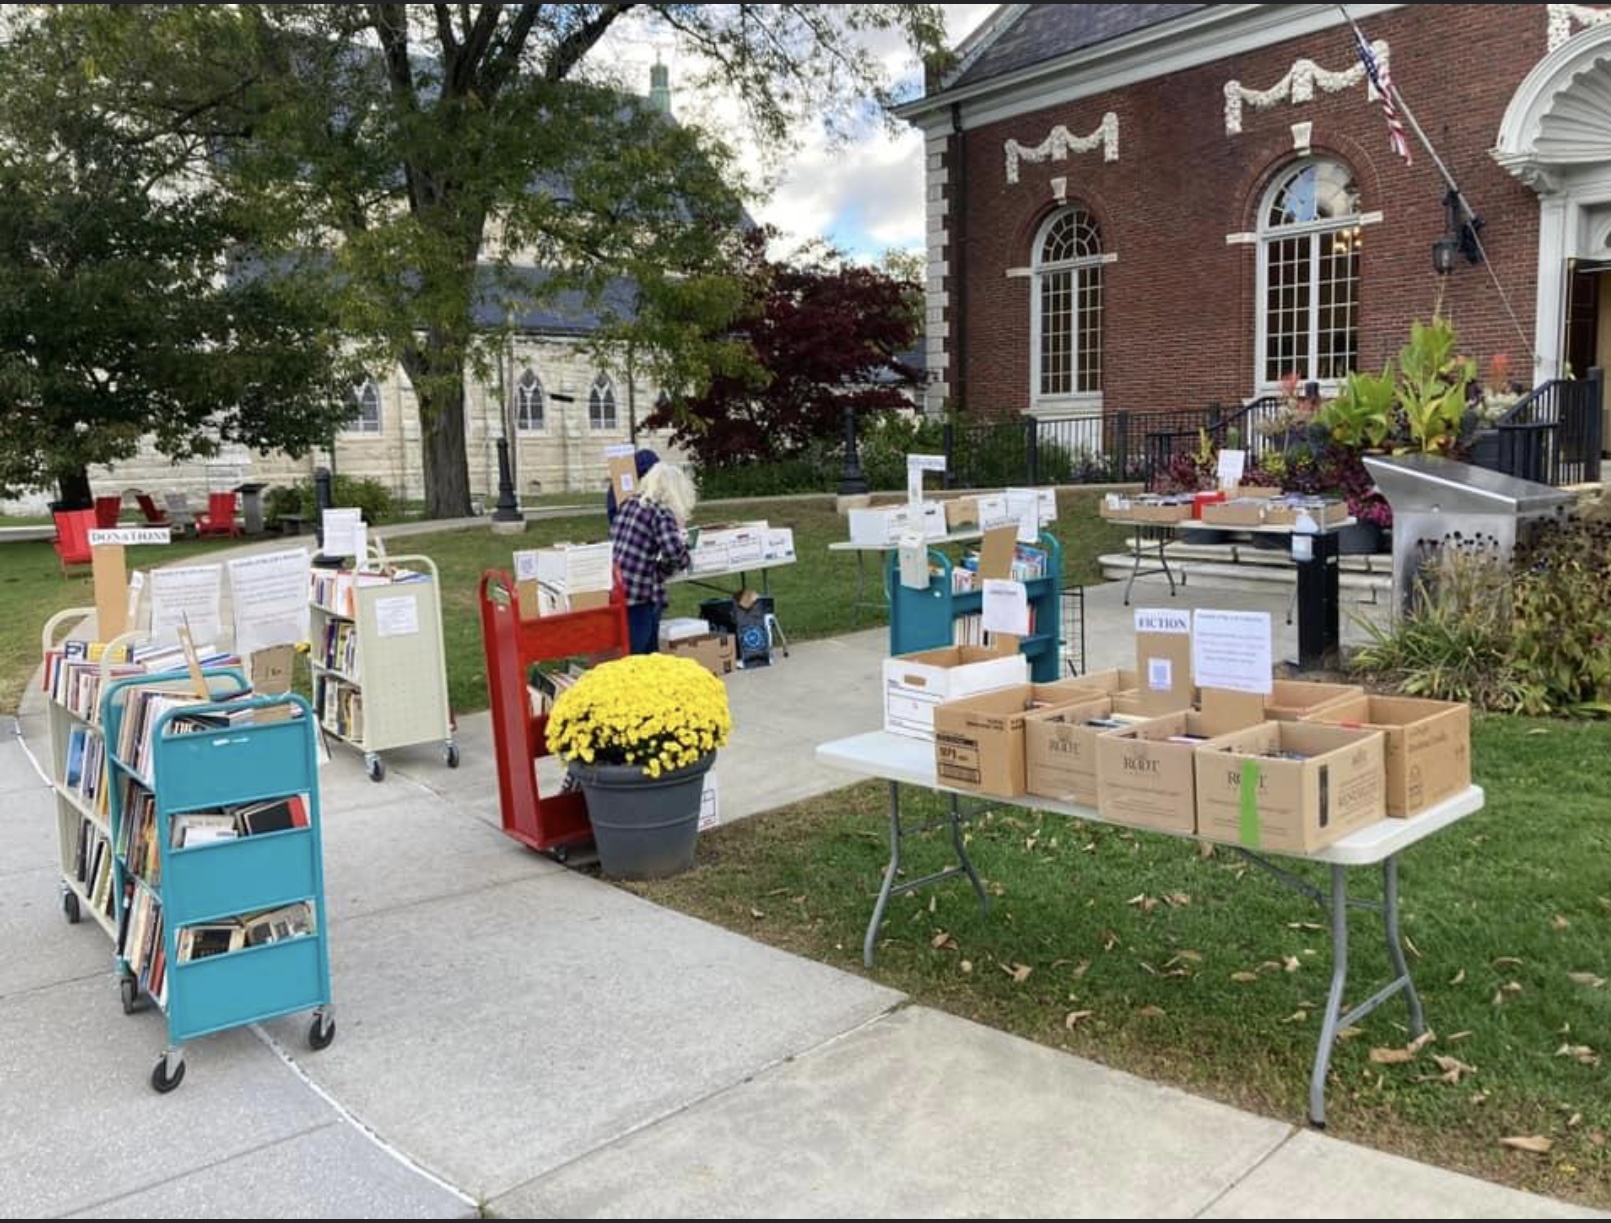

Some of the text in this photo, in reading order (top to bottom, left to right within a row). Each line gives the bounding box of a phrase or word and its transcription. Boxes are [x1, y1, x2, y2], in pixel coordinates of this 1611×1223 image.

[92, 530, 168, 542] DONATIONS
[1138, 616, 1187, 629] FICTION
[1123, 755, 1160, 772] ROOT
[1227, 770, 1268, 788] ROT
